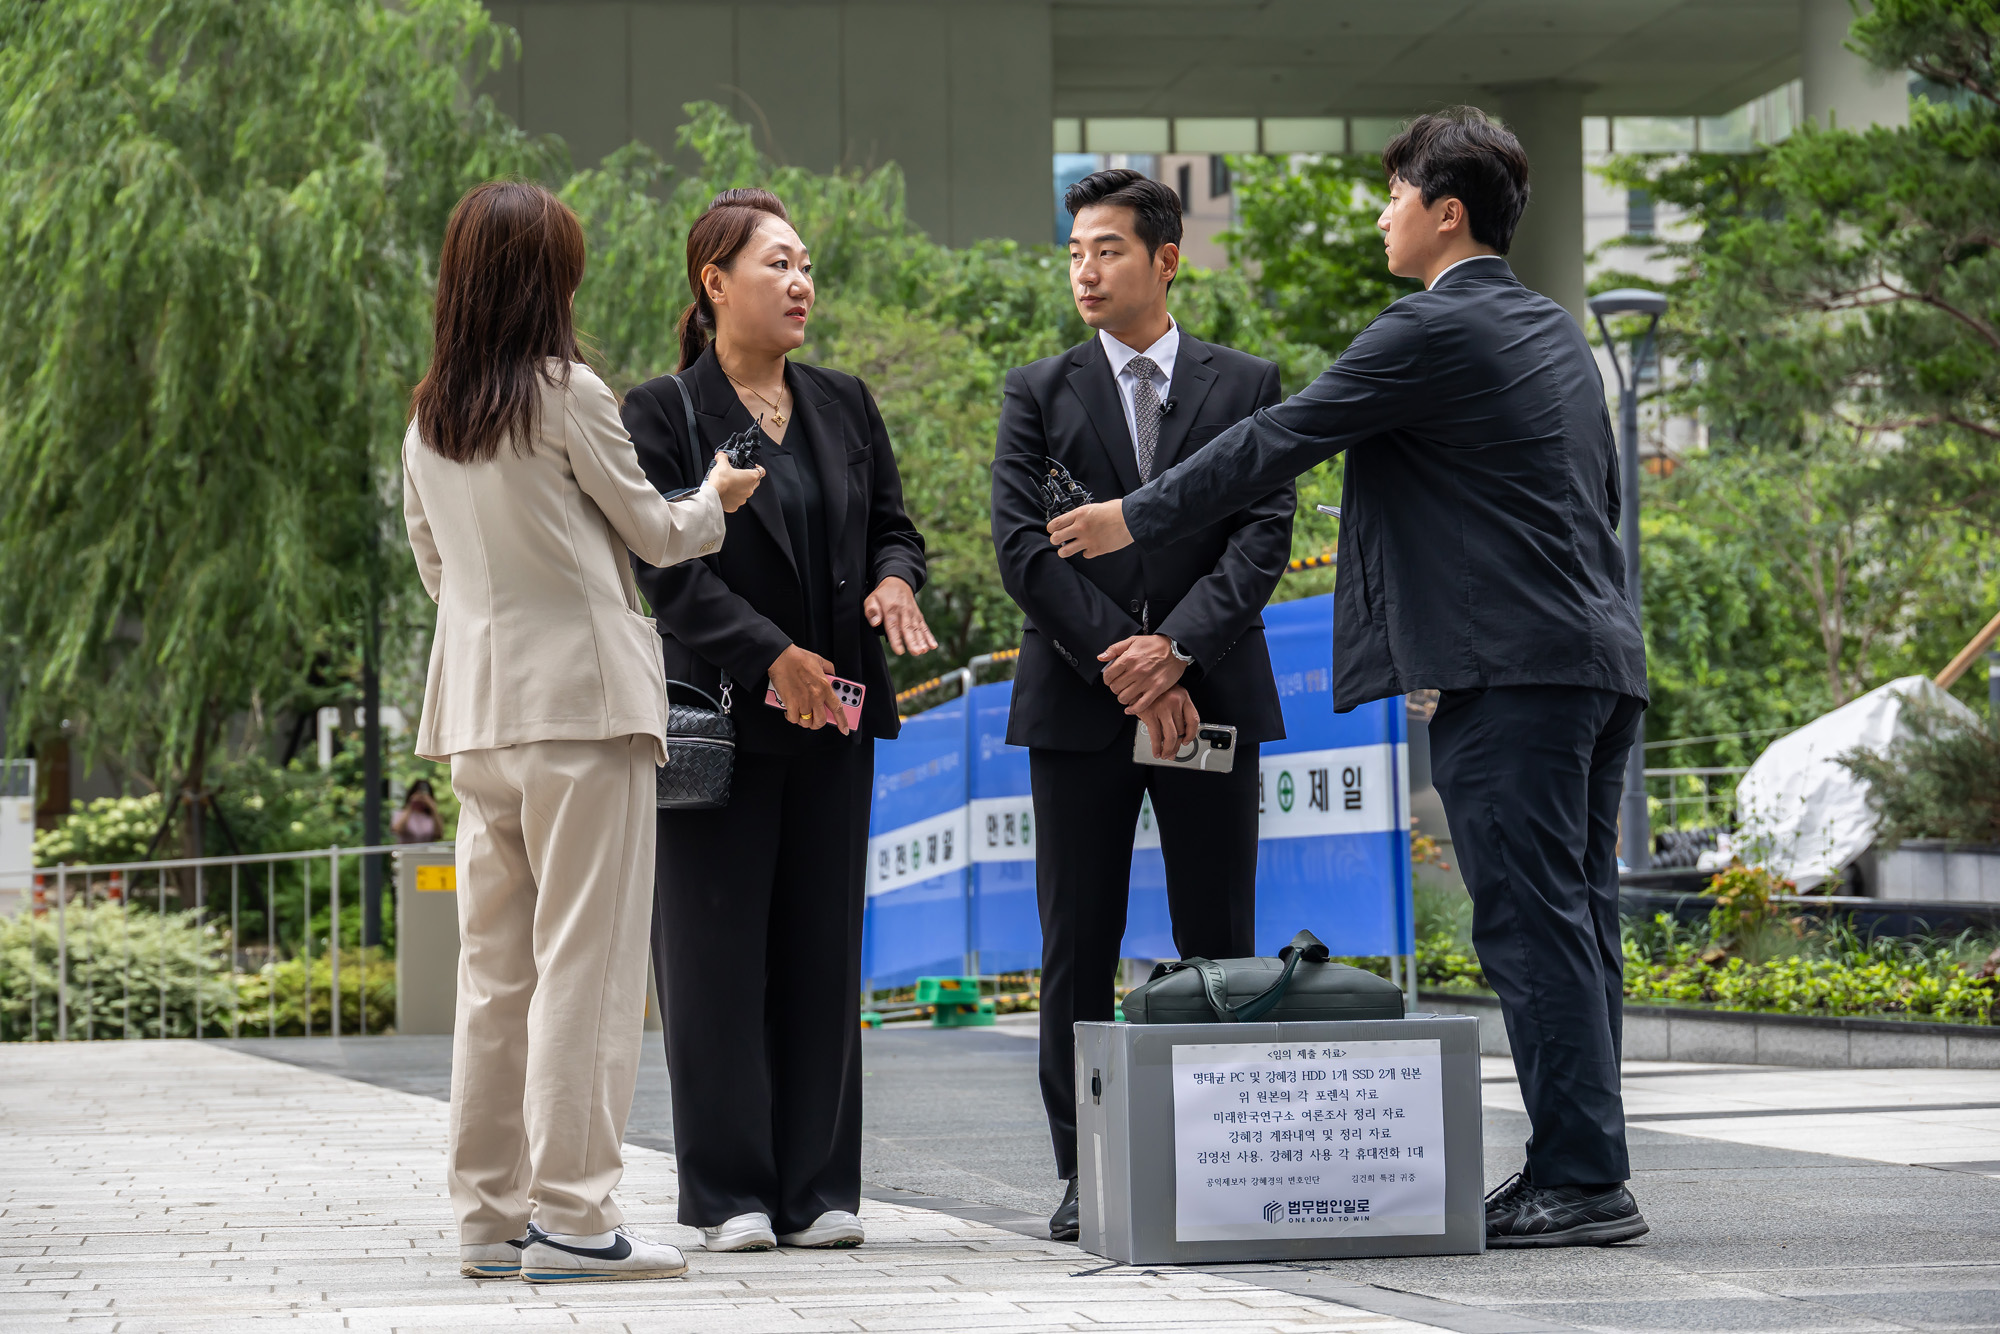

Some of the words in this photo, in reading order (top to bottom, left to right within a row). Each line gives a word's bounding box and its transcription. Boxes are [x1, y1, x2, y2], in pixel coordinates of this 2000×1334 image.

[1308, 766, 1362, 812] 제일
[986, 813, 1015, 847] 안전
[1268, 1050, 1291, 1060] <임의
[1297, 1049, 1316, 1059] 제출
[1322, 1048, 1347, 1059] 자료>
[1193, 1072, 1226, 1085] 명태균
[1230, 1072, 1244, 1082] PC
[1250, 1071, 1260, 1083] 및
[1266, 1071, 1297, 1083] 강혜경
[1302, 1070, 1326, 1081] HDD
[1332, 1069, 1348, 1081] 1개
[1352, 1069, 1374, 1080] SSD
[1378, 1067, 1396, 1080] 2개
[1400, 1067, 1422, 1080] 원본
[1239, 1091, 1249, 1103] 위
[1257, 1090, 1290, 1103] 원본의
[1298, 1090, 1309, 1102] 각
[1315, 1089, 1349, 1101] 포렌식
[1356, 1088, 1379, 1100] 자료
[1213, 1111, 1295, 1124] 미래한국연구소
[1301, 1109, 1347, 1122] 여론조사
[1354, 1108, 1375, 1121] 정리
[1382, 1107, 1406, 1120] 자료
[1229, 1131, 1262, 1144] 강혜경
[1270, 1130, 1315, 1142] 계좌내역
[1322, 1129, 1333, 1141] 및
[1340, 1128, 1362, 1141] 정리
[1369, 1128, 1392, 1140] 자료
[1197, 1151, 1230, 1164] 김영선
[1270, 1150, 1303, 1162] 강혜경
[1310, 1149, 1333, 1161] 사용
[1339, 1148, 1349, 1160] 각
[1356, 1147, 1400, 1160] 휴대전화
[1407, 1146, 1424, 1159] 1대
[1206, 1178, 1246, 1187] 공익제보자
[1251, 1177, 1283, 1187] 강혜경의
[1288, 1199, 1370, 1215] 법무법인일로
